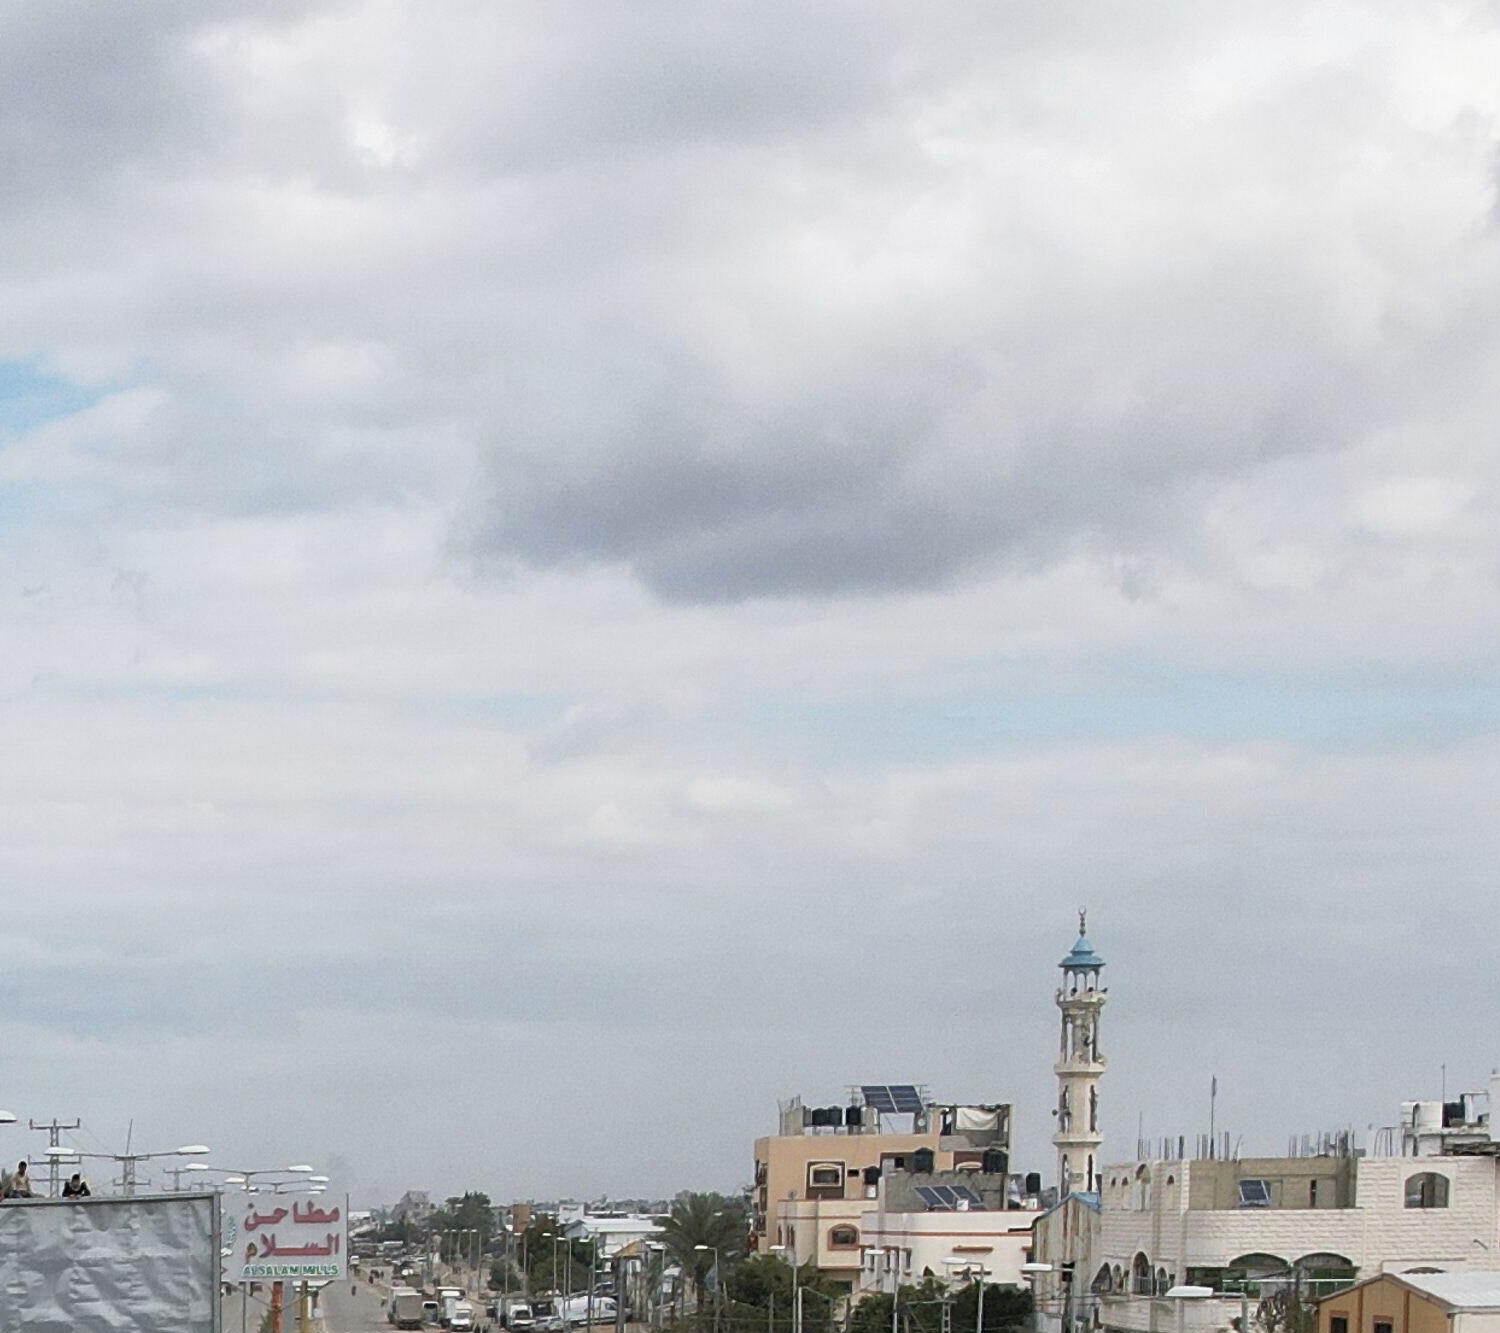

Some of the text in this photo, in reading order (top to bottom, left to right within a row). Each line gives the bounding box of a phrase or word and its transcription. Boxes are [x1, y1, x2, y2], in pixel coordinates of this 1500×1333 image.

[244, 1201, 340, 1231] مطاحن
[244, 1233, 340, 1264] السلام
[243, 1265, 339, 1276] ALSALAM MILLS
